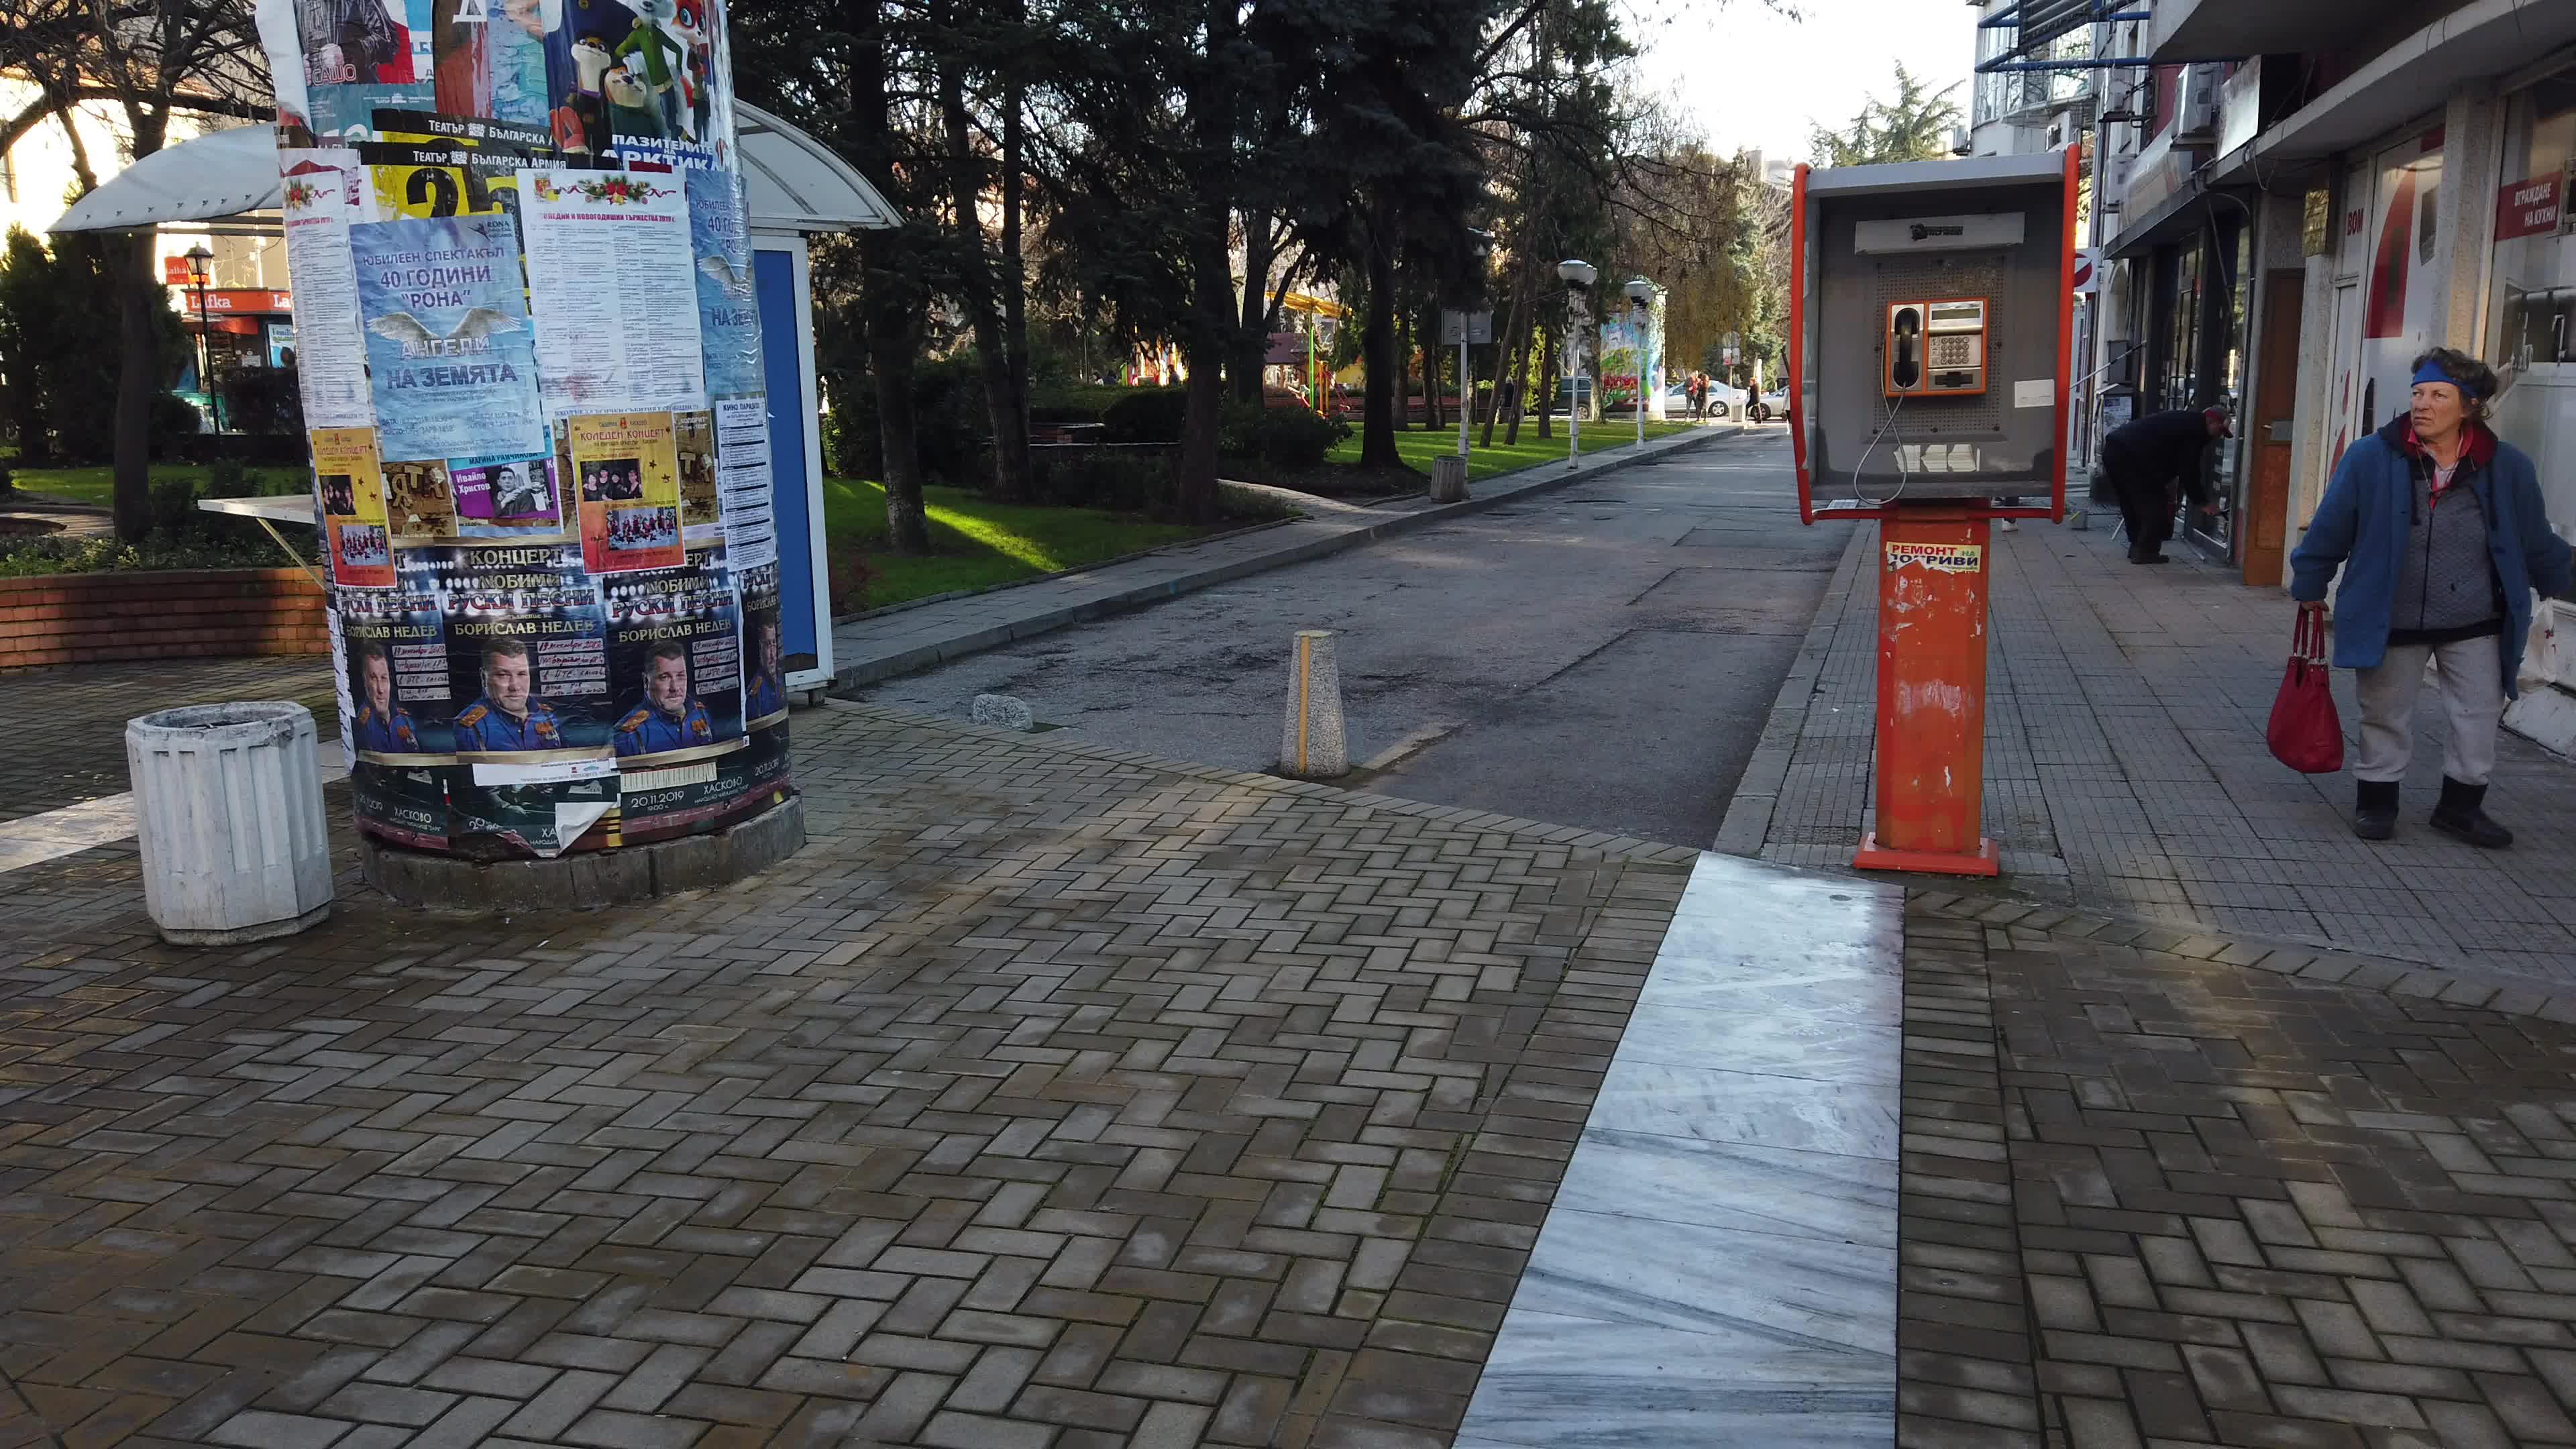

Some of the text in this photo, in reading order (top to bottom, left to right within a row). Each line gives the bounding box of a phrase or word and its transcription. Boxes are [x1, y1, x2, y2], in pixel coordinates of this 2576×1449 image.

[428, 119, 464, 133] ТЕАТЪР
[489, 127, 545, 144] БЪЛГАРСКА
[612, 134, 714, 155] ПАЗИТЕЛИТЕ
[413, 150, 567, 169] ТЕАТЪР БЪЛГАРСКА АРМИЯ
[363, 247, 504, 266] ЮБИЛЕЕН СПЕКТАКЪЛ
[380, 265, 492, 288] 40 ГОДИНИ
[400, 336, 492, 360] АНГЕЛИ
[387, 363, 519, 389] НА ЗЕМЯТА
[580, 428, 665, 441] КОЛЕДЕН КОНЦЕРТ
[455, 472, 486, 484] Ивайло
[458, 482, 492, 496] Христов
[470, 549, 564, 567] КОНЦЕРТ
[1892, 544, 1957, 556] РЕМОНТ
[1889, 553, 1978, 567] ОРИВИ
[477, 573, 561, 590] ЛЮБИМИ
[643, 576, 710, 596] ЛЮБИМИ
[375, 594, 437, 612] ПЕСНИ
[447, 588, 596, 610] РУСКИ ПЕСНИ
[611, 589, 734, 619] РУСКИ ПЕСНИ
[345, 625, 437, 638] БОРИСЛАВ НЕДЕВ
[455, 620, 594, 636] БОРИСЛАВ НЕДЕВ
[619, 618, 731, 643] БОРИСЛАВ НЕДЕВ
[631, 790, 685, 808] 20.11.2019
